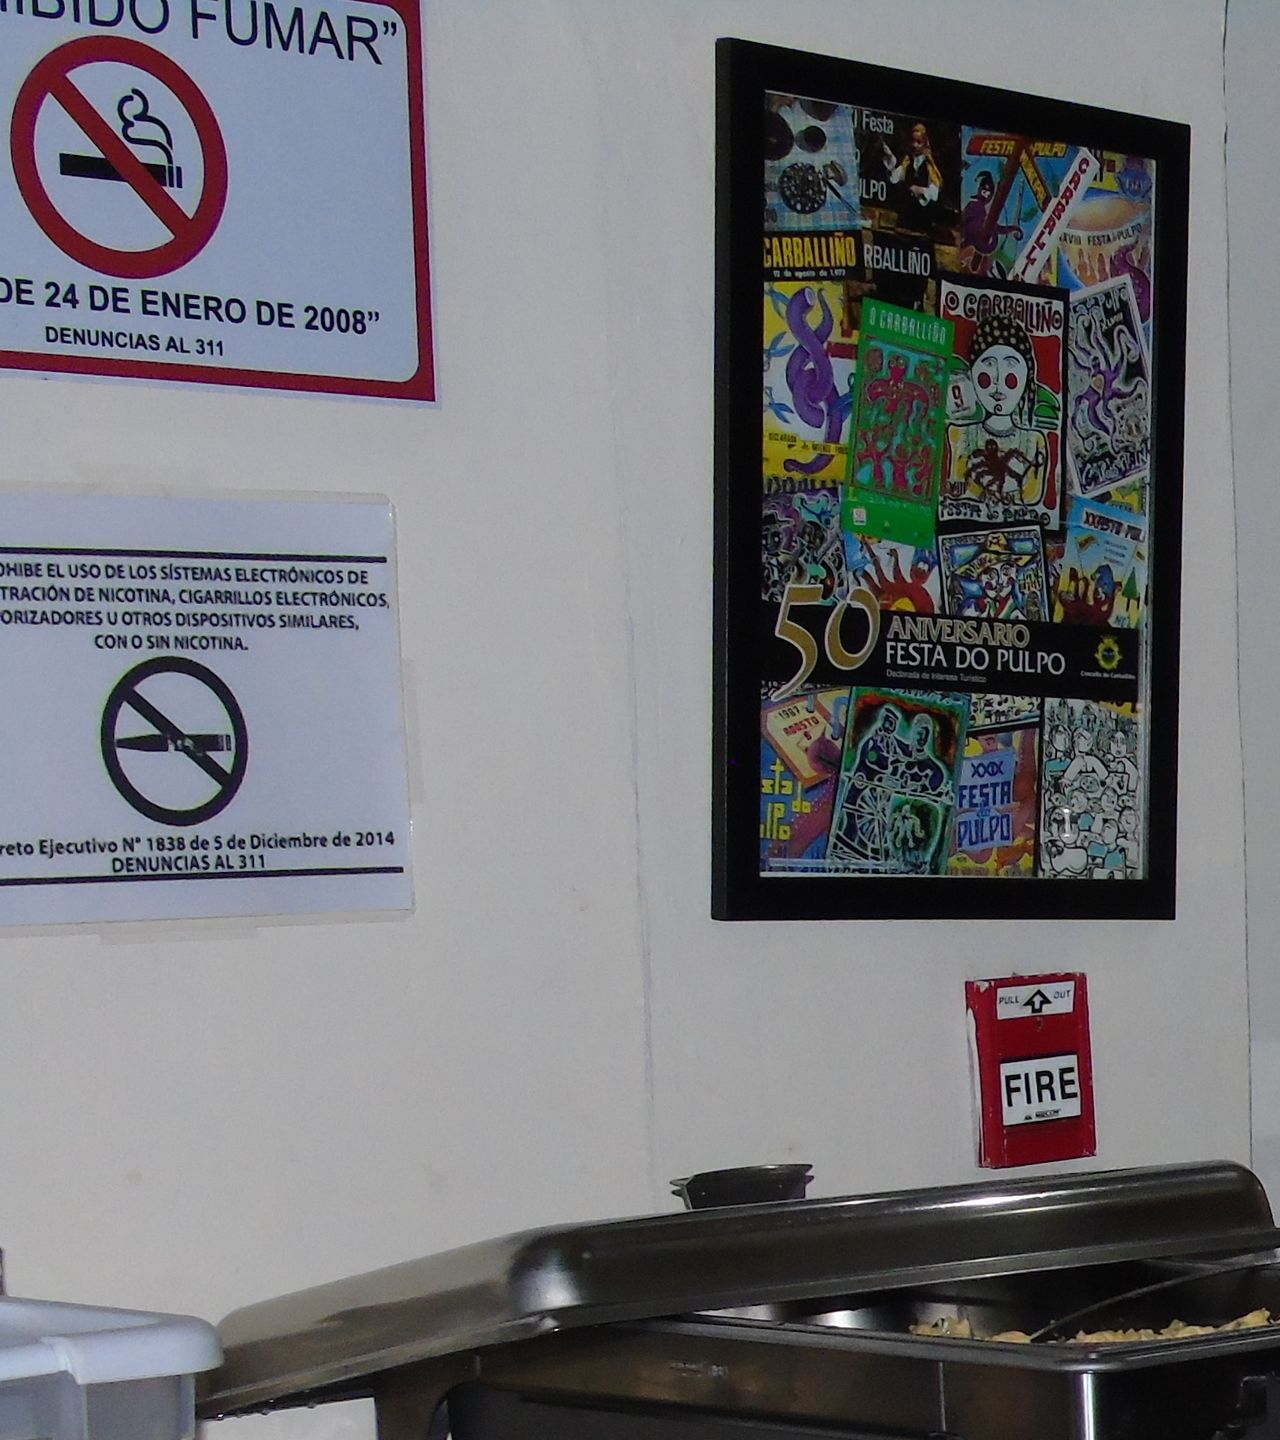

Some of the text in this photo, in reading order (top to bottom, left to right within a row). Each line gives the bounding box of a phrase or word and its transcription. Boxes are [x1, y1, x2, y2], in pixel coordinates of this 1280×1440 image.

[861, 111, 895, 135] Festa
[44, 281, 80, 309] 24
[89, 285, 131, 314] DE
[141, 289, 247, 324] ENERO
[256, 300, 295, 328] DE
[945, 291, 960, 311] O
[963, 293, 1063, 332] CARBALLIÑO
[45, 326, 224, 357] DENUNCIAS AL 311
[47, 563, 65, 579] EL
[68, 564, 100, 579] USO
[105, 565, 126, 579] DE
[130, 564, 157, 580] LOS
[235, 566, 344, 585] ELECTRÓNICOS
[347, 570, 369, 585] DE
[74, 587, 96, 602] DE
[99, 588, 176, 606] NICOTINA,
[179, 589, 272, 606] CIGARRILLOS
[276, 590, 390, 609] ELECTRÓNICOS,
[0, 610, 360, 631] ORIZADORES U OTROS DISPOSITIVOS SIMILARES,
[886, 615, 1031, 648] ANIVERSARIO
[94, 634, 249, 651] CON O SIN NICOTINA.
[772, 583, 881, 701] 50
[884, 641, 1066, 676] FESTA DO PULPO
[958, 780, 1012, 809] FESTA
[38, 838, 118, 859] Ejecutivo
[147, 836, 186, 852] 1838
[190, 835, 209, 850] de
[214, 836, 223, 850] 5
[227, 834, 246, 850] de
[250, 832, 328, 849] Diciembre
[332, 831, 351, 847] de
[355, 831, 395, 847] 2014
[957, 813, 1011, 849] PULPO
[112, 854, 266, 873] DENUNCIAS AL 311
[999, 989, 1071, 1005] PULL OUT
[1004, 1066, 1078, 1108] FIRE
